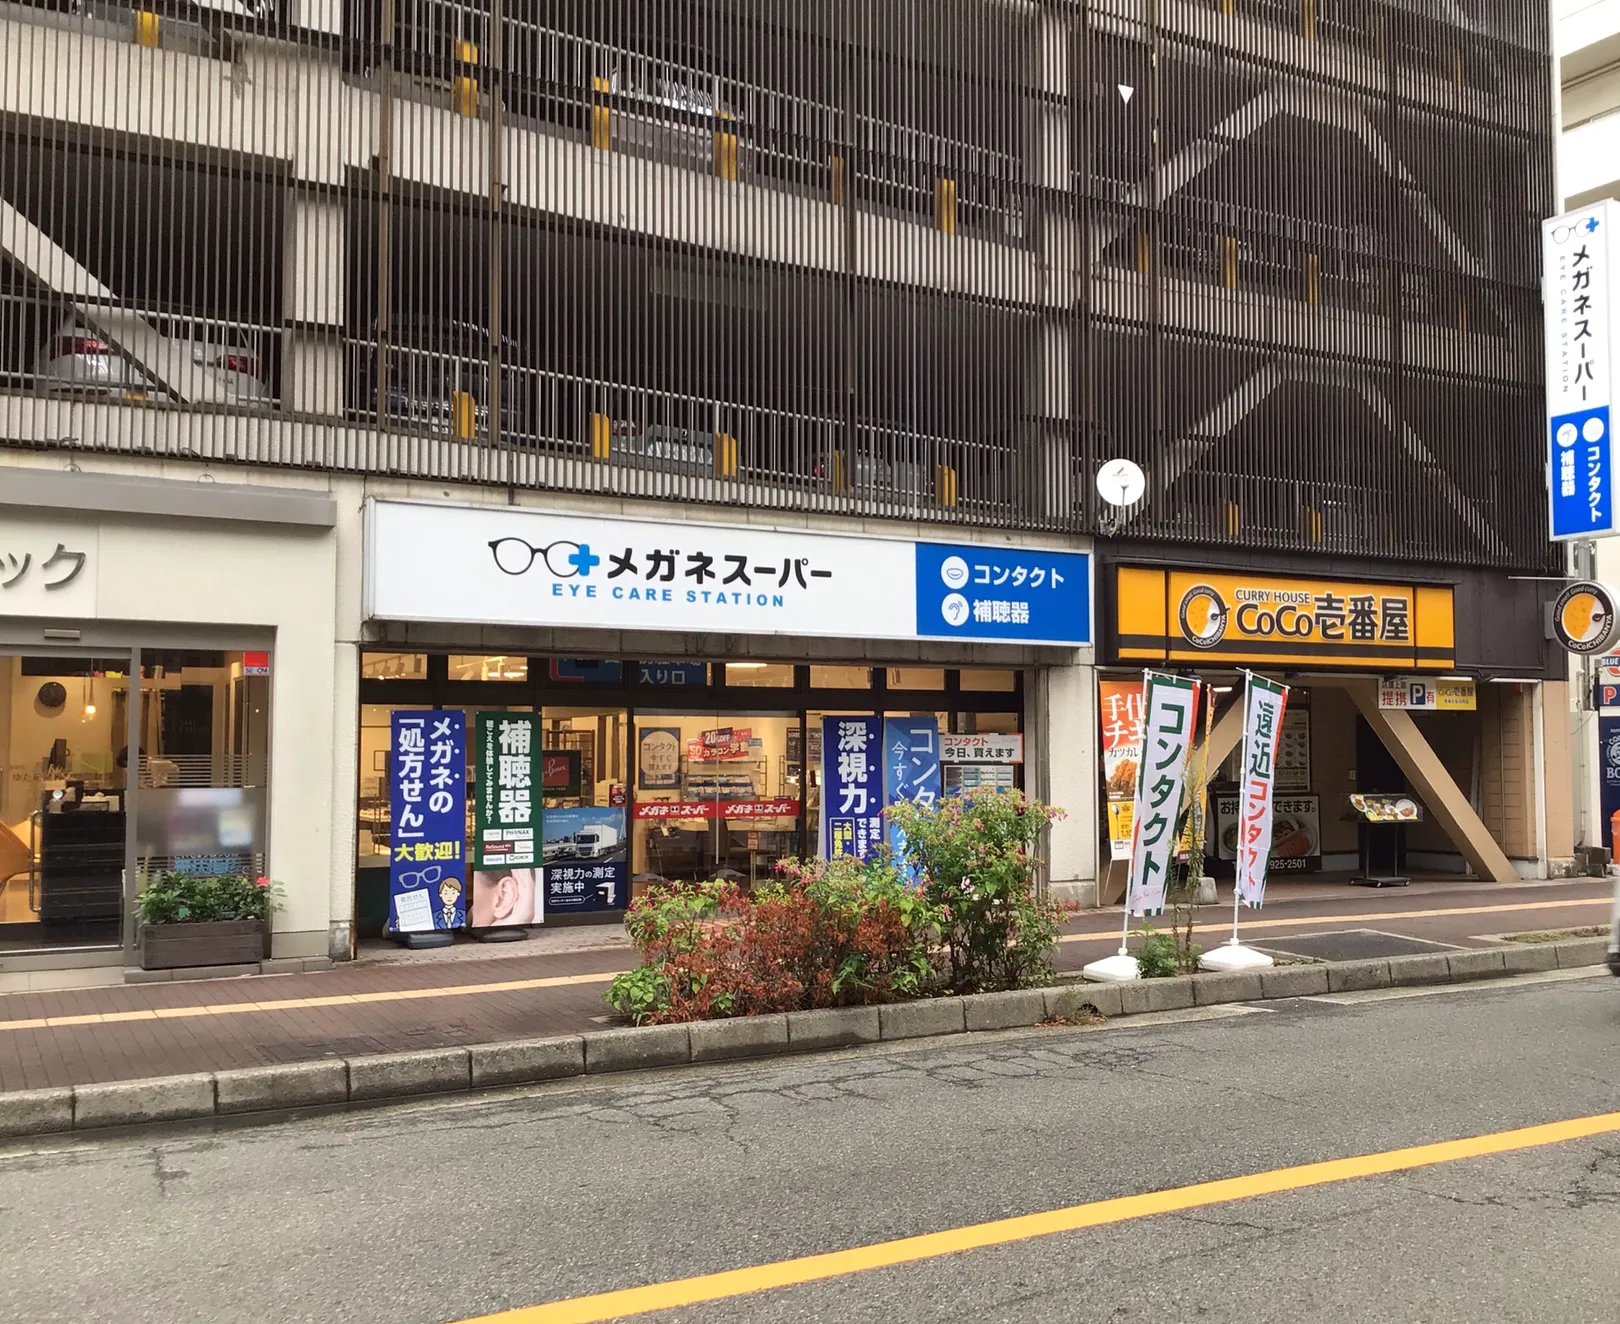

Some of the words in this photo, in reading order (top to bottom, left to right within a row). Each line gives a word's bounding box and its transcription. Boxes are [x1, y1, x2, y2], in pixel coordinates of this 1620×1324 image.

[1572, 244, 1595, 401] メガネスーパー
[1561, 332, 1569, 393] STATION
[1587, 446, 1602, 522] コンタクト
[607, 547, 832, 590] メガネスーパー
[974, 565, 1064, 589] コンタクト
[552, 583, 597, 598] EYE
[612, 586, 673, 602] CARE
[686, 590, 785, 607] STATION
[1235, 589, 1271, 601] CURRY
[1273, 591, 1310, 604] HOUSE
[973, 600, 1030, 624] 補聴器
[1236, 593, 1409, 641] CoCo壱番屋
[639, 669, 686, 685] 入り口
[1603, 686, 1616, 705] P
[643, 742, 676, 751] コンタクト
[945, 737, 988, 746] コンタクト
[945, 747, 1015, 758] 今日、買えます
[429, 717, 454, 814] メガネの
[650, 754, 671, 762] 今すぐ
[838, 721, 867, 814] 深視力
[910, 729, 938, 811] コンタ
[398, 718, 425, 838] 「処方せん」
[499, 720, 532, 823] 補聴器
[1142, 703, 1185, 885] コンタクト
[869, 818, 880, 840] 測定
[394, 841, 461, 862] 大歓迎!
[551, 866, 616, 880] 深視力の測定
[551, 881, 585, 894] 実施中
